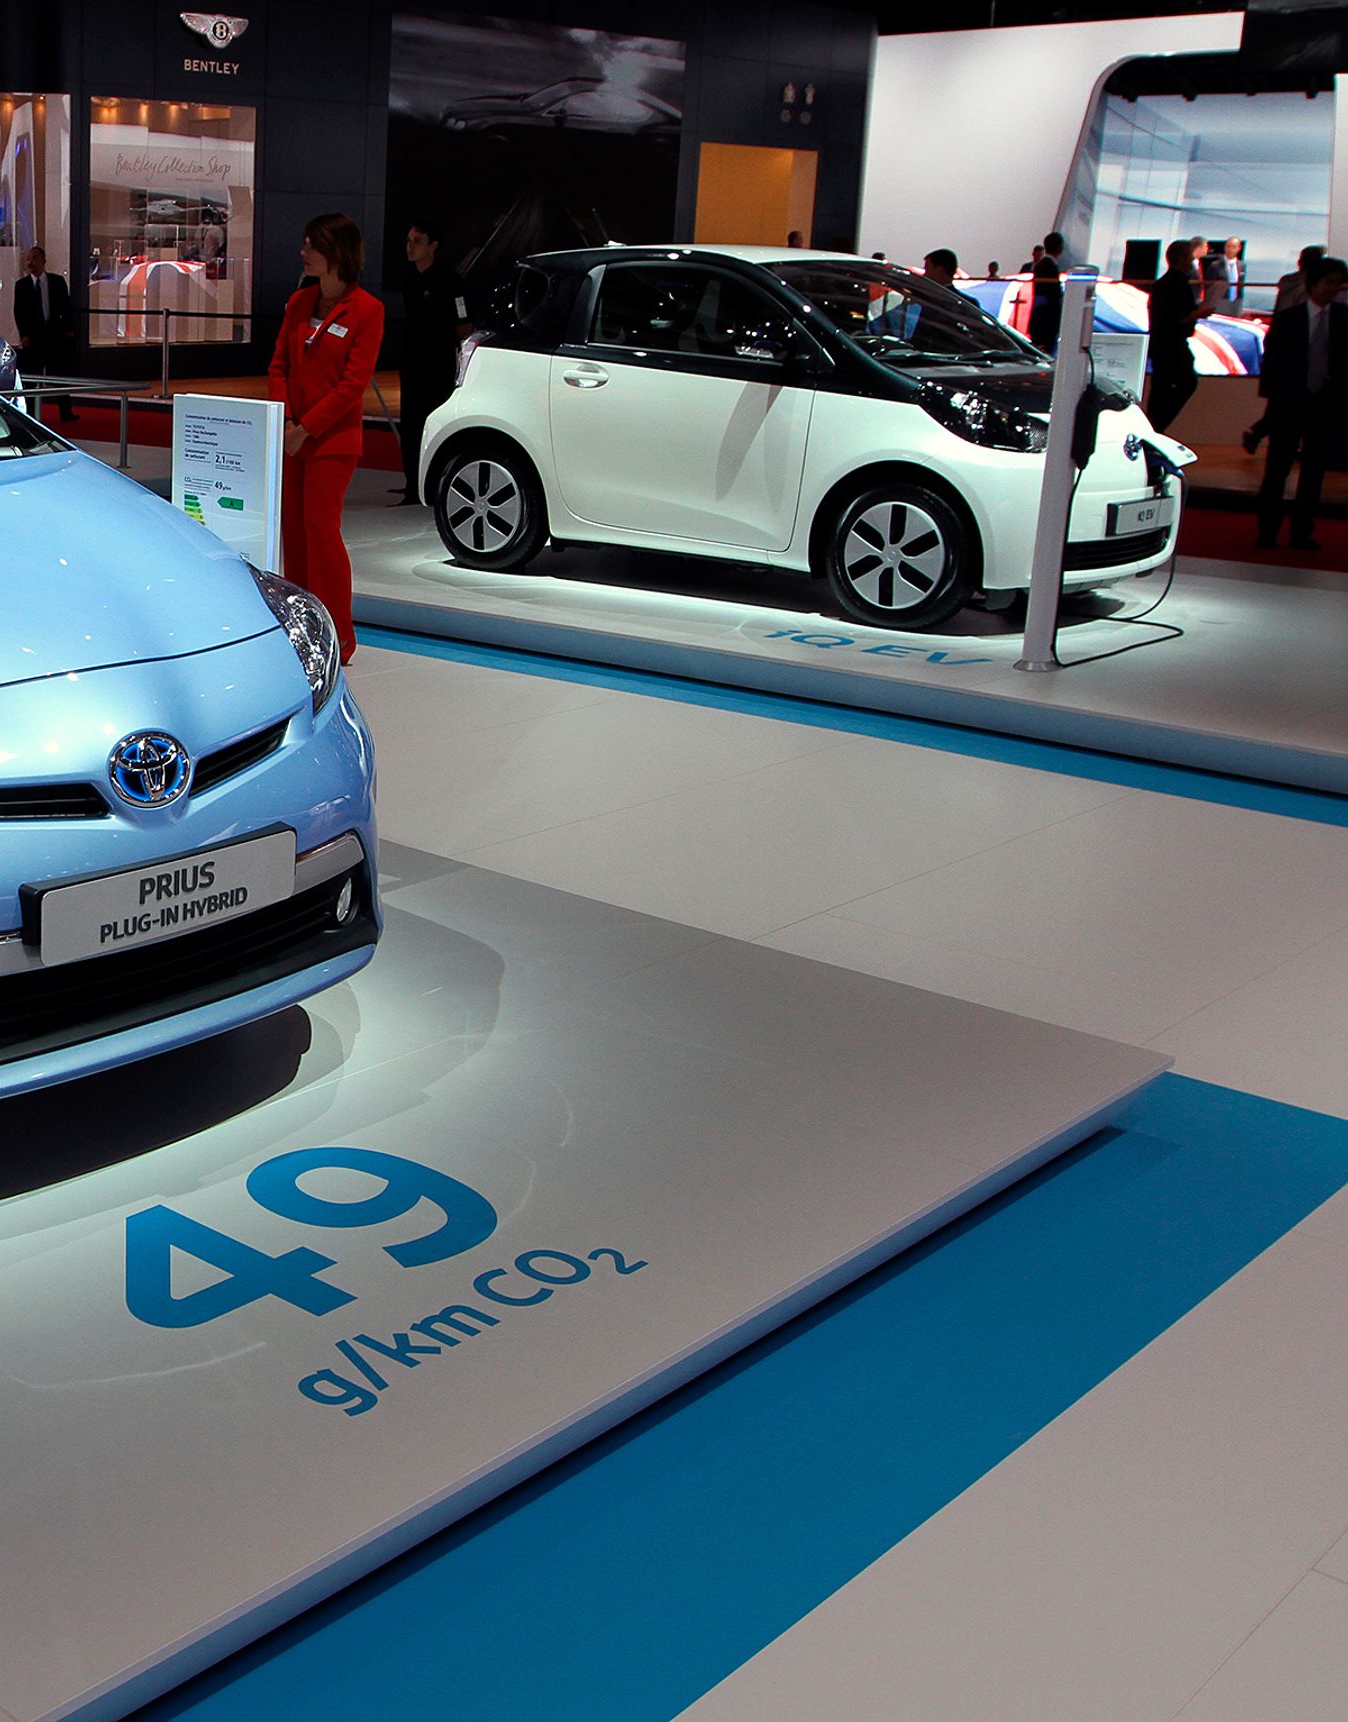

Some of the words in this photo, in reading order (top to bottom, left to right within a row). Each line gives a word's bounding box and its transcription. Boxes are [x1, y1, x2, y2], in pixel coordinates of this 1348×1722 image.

[184, 59, 240, 75] BENTLEY
[115, 153, 158, 177] Bentley
[157, 156, 205, 174] Collection
[205, 155, 231, 181] Shop
[860, 644, 993, 665] EV
[139, 861, 216, 904] PRIUS
[100, 904, 178, 943] PLUG-IN
[182, 887, 248, 921] HYBRID
[125, 1146, 498, 1329] 49
[297, 1303, 501, 1418] g/km
